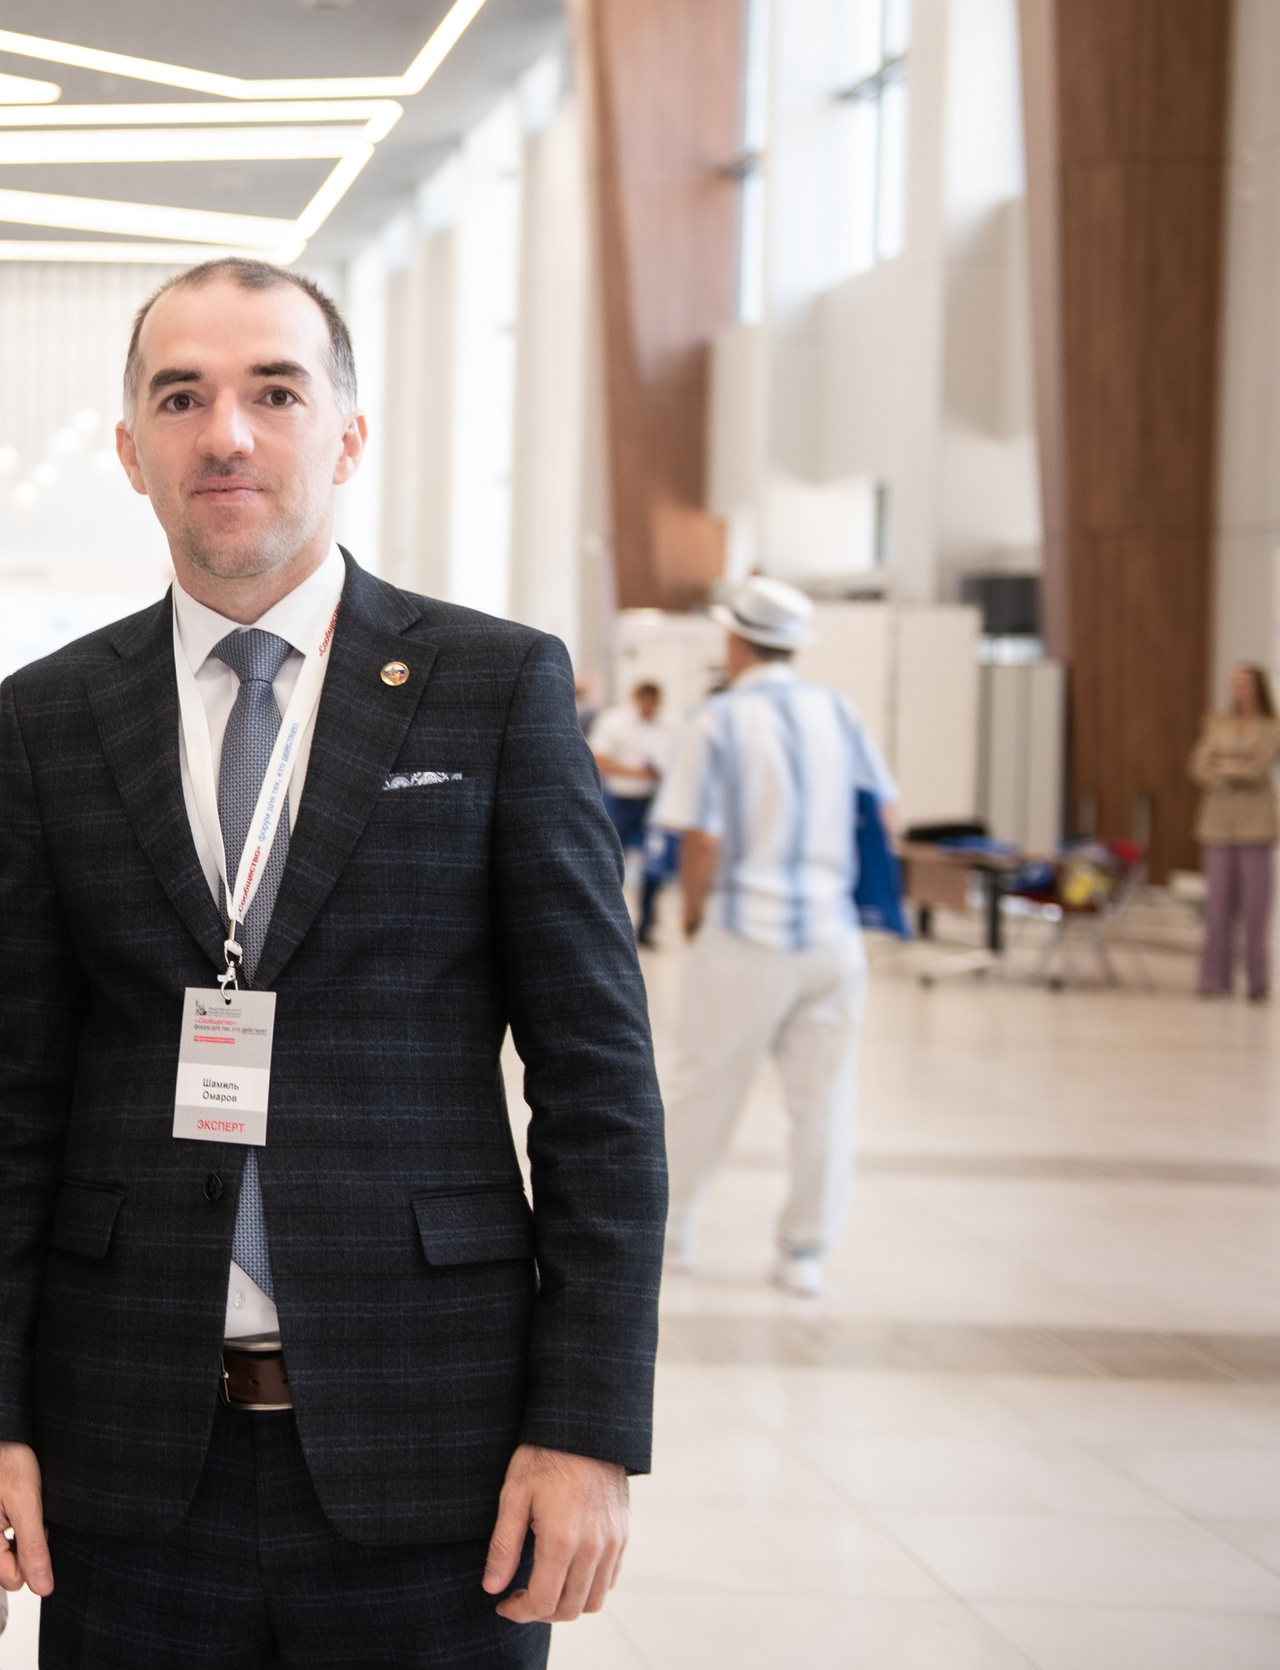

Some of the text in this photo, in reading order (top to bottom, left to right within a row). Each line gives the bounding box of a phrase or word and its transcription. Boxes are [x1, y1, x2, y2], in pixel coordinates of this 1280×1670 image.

[202, 1078, 239, 1091] Шамиль
[202, 1090, 238, 1103] Омаров
[197, 1119, 245, 1134] ЭКСПЕРТ
